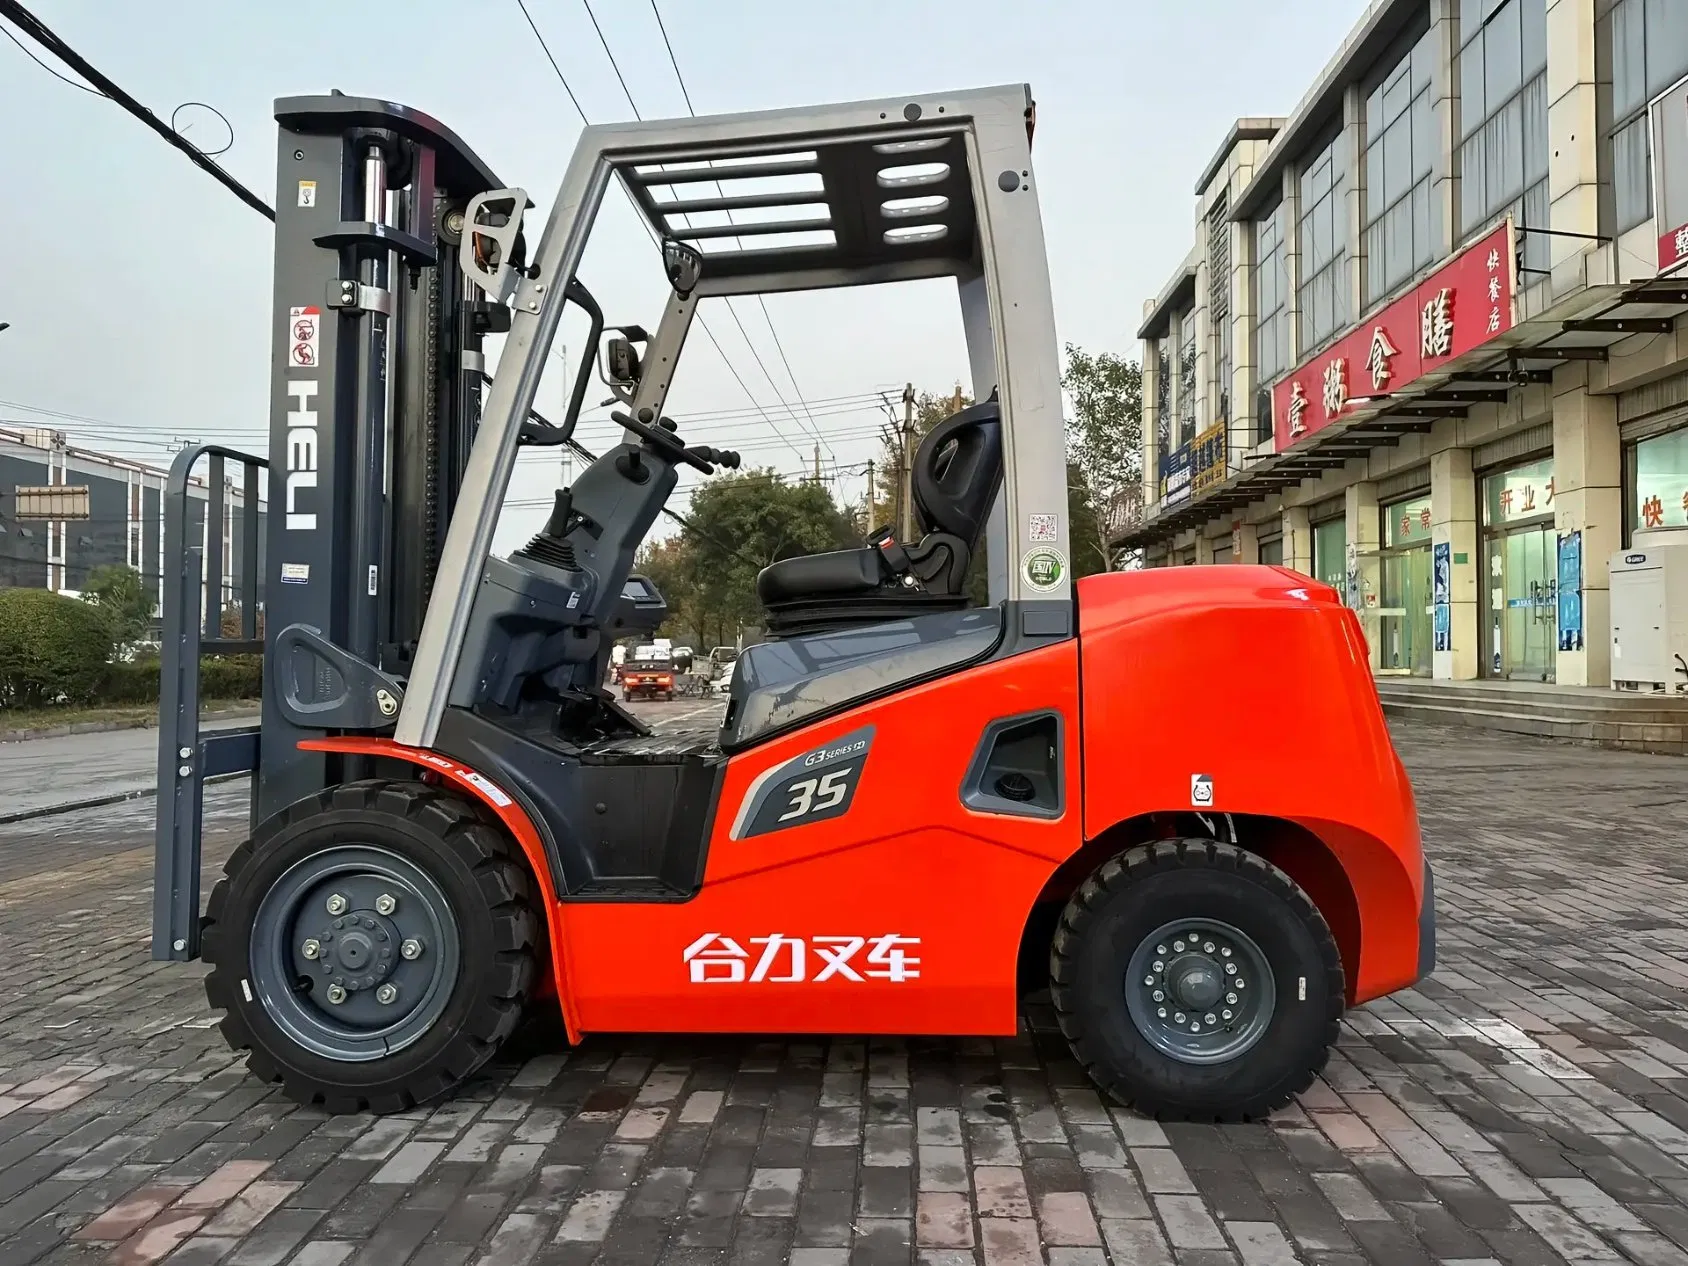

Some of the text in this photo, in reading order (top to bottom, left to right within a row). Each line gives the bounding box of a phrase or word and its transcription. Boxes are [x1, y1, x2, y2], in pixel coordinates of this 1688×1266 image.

[1486, 248, 1502, 334] 快餐店
[286, 380, 318, 530] HELI
[805, 746, 852, 766] G3 SERIES
[779, 768, 852, 822] 35
[683, 933, 921, 983] 合力叉车
